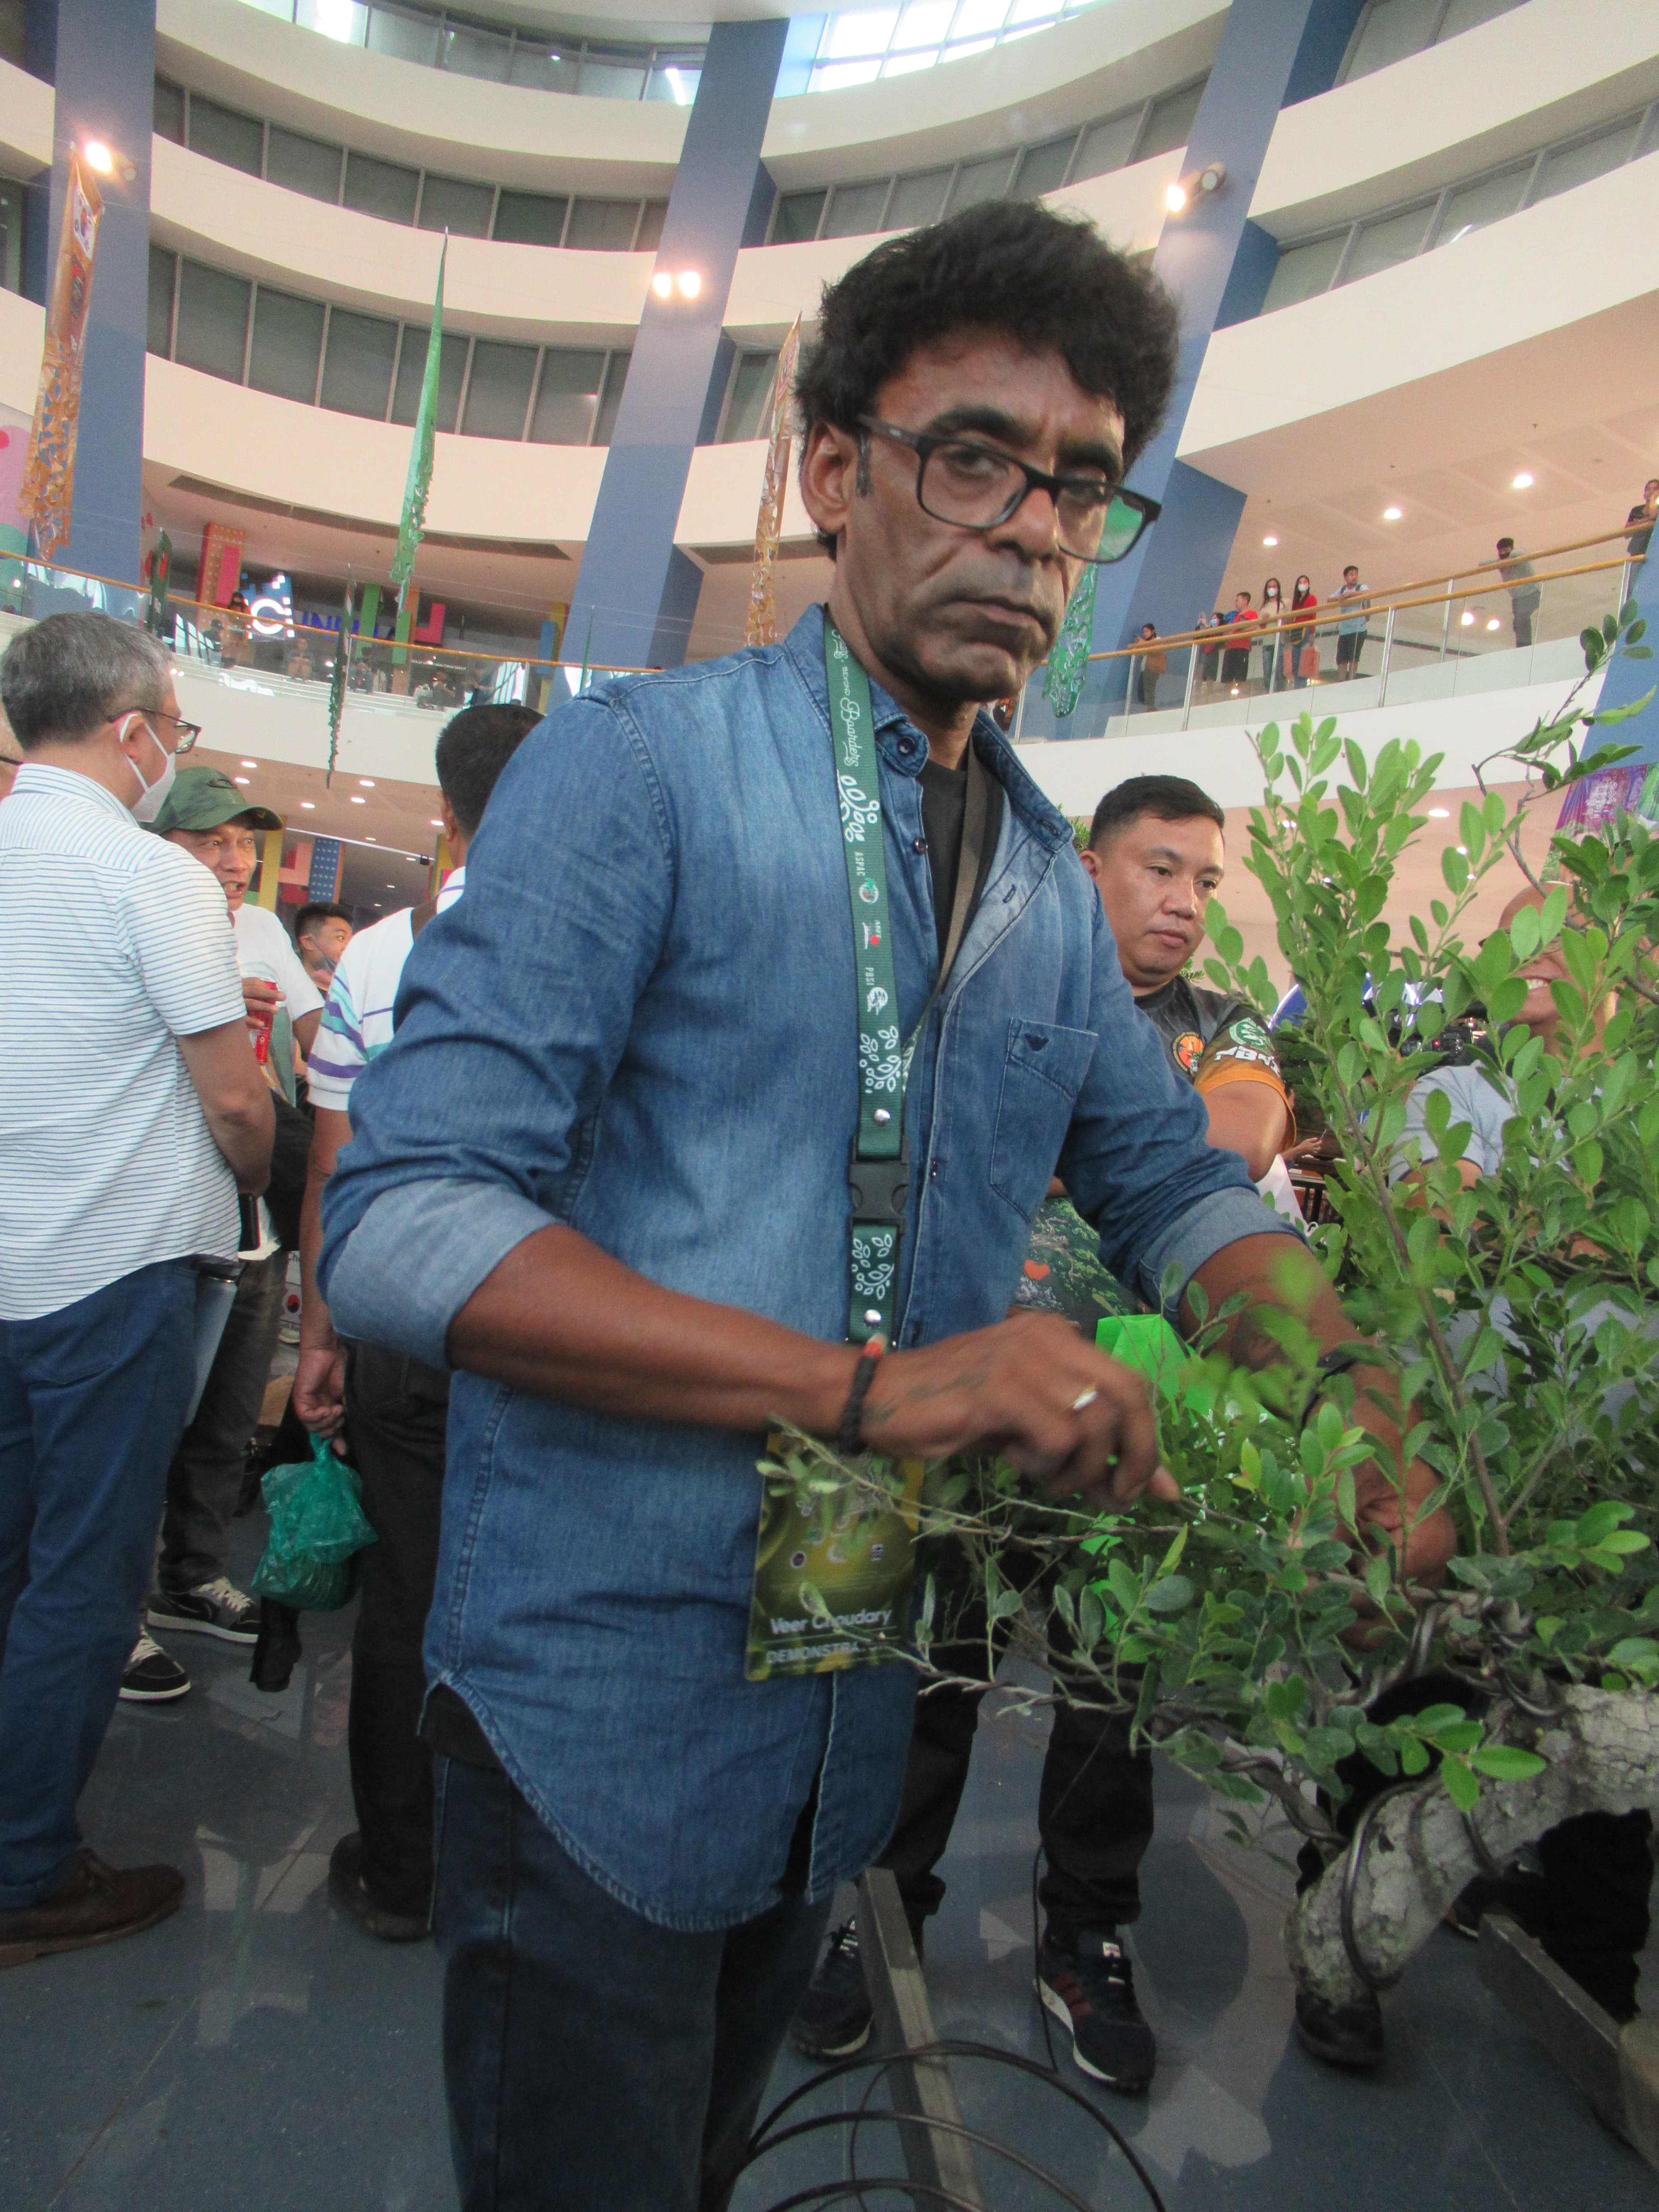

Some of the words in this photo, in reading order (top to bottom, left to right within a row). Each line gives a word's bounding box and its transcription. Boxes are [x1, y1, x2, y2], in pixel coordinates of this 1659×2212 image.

[842, 666, 851, 696] BEYOND
[854, 851, 866, 877] ASPAC
[865, 966, 875, 986] PBSI
[770, 1617, 808, 1635] Veer
